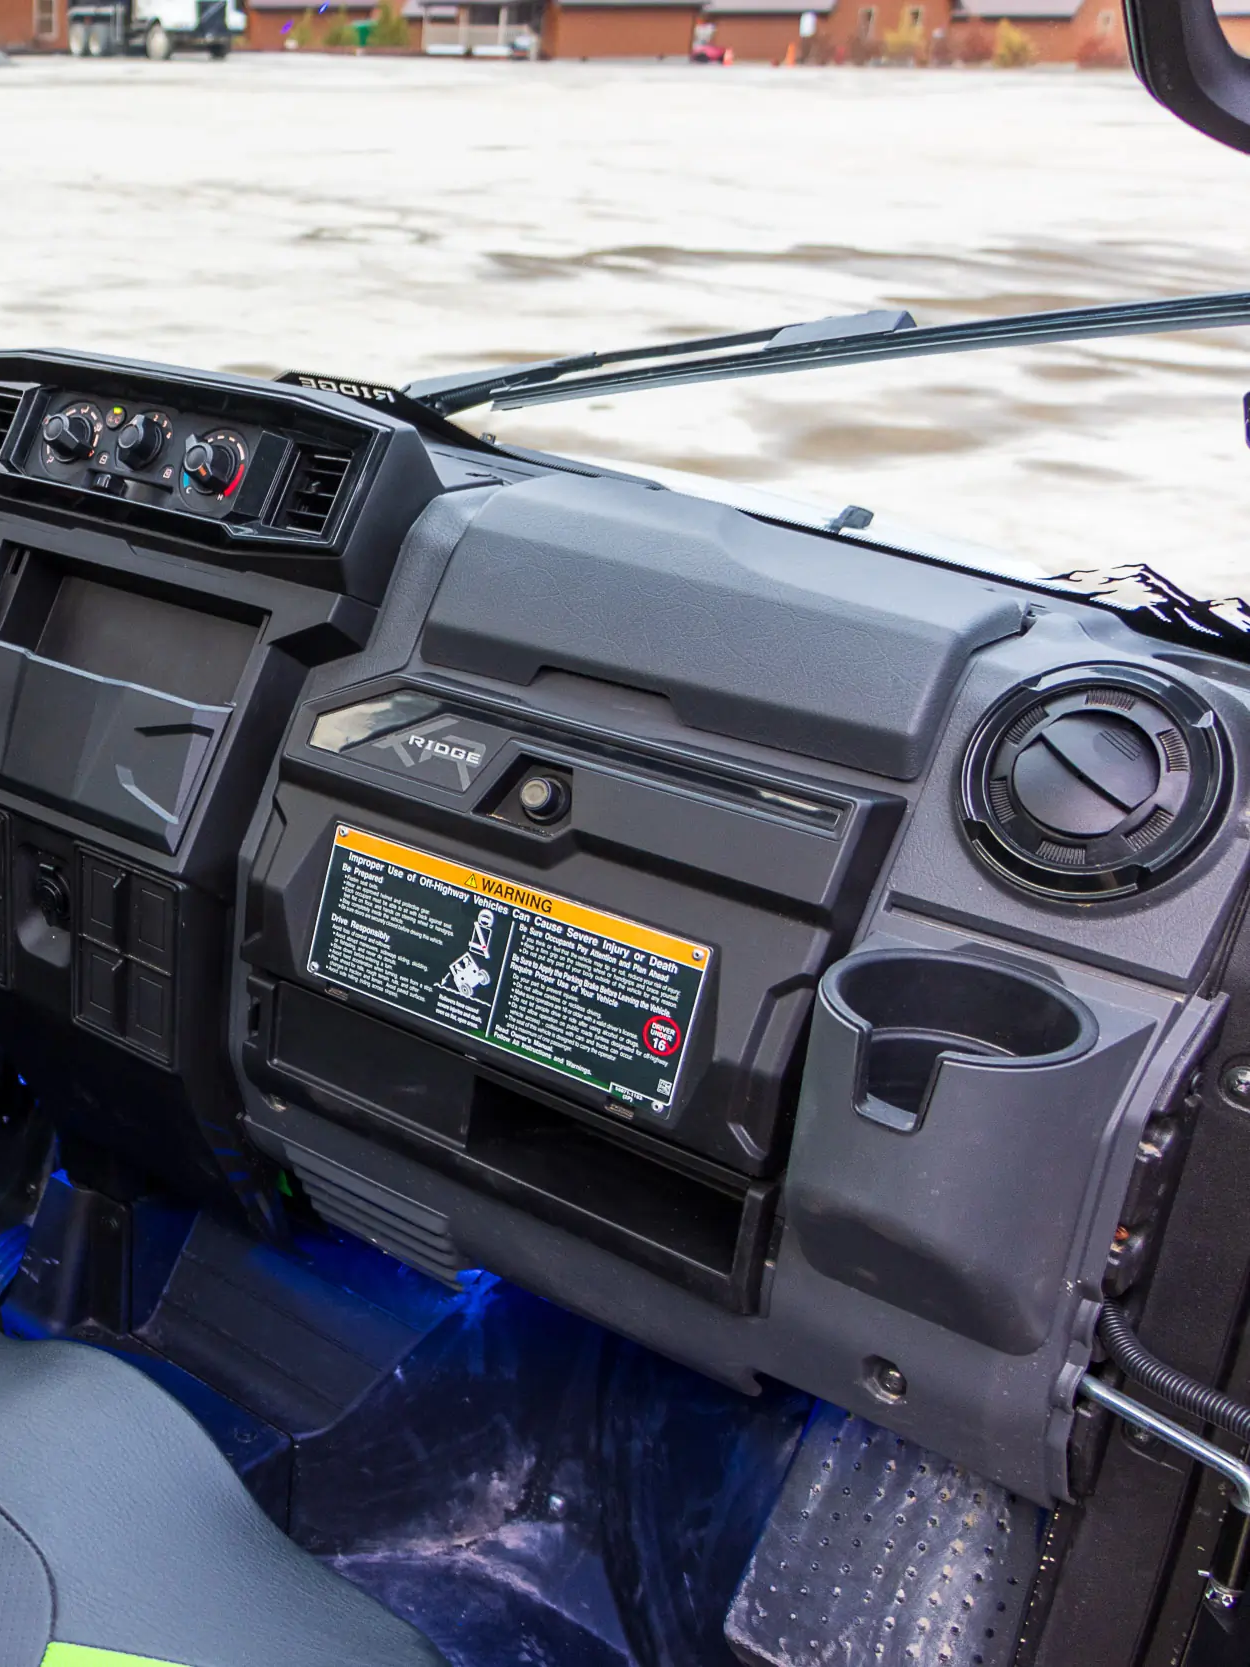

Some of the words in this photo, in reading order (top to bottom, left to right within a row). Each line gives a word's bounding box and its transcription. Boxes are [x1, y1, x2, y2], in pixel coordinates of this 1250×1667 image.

[408, 734, 482, 765] RIDGE
[341, 862, 352, 873] Be
[353, 866, 384, 884] Prepared
[481, 877, 553, 914] WARNING
[330, 912, 349, 926] Drive
[350, 919, 391, 943] Responsibly
[348, 851, 385, 872] Improper
[387, 864, 404, 879] Use
[406, 873, 417, 883] of
[419, 876, 470, 903] Off-Highway
[473, 894, 509, 915] Vehicles
[512, 908, 531, 923] Can
[533, 915, 564, 934] Cause
[566, 926, 599, 947] Severe
[602, 939, 631, 958] Injury
[633, 952, 646, 962] or
[648, 955, 679, 975] Death
[518, 923, 528, 933] Be
[528, 926, 544, 939] Sure
[544, 932, 576, 950] Occupants
[576, 943, 589, 956] Pay
[589, 948, 618, 965] Attention
[618, 959, 632, 970] and
[632, 962, 648, 975] Plan
[648, 968, 670, 983] Ahead
[509, 961, 534, 977] Require
[534, 970, 556, 984] Proper
[556, 978, 570, 990] Use
[570, 984, 581, 993] of
[579, 985, 595, 999] Your
[596, 992, 619, 1008] Vehicle
[511, 952, 520, 963] Be
[519, 955, 533, 968] Sure
[532, 960, 539, 970] to
[537, 962, 555, 976] Apply
[553, 968, 563, 979] the
[562, 971, 584, 988] Parking
[583, 978, 600, 992] Brake
[599, 984, 618, 999] Before
[617, 991, 640, 1008] Leaving
[639, 1000, 650, 1010] the
[494, 1023, 510, 1035] Read
[510, 1030, 532, 1044] Owner's
[650, 1028, 673, 1042] UNDER
[651, 1021, 677, 1037] DRIVER
[652, 1037, 667, 1052] 16
[493, 1030, 511, 1043] Follow
[511, 1038, 521, 1047] All
[520, 1042, 552, 1060] Instructions
[552, 1055, 565, 1065] and
